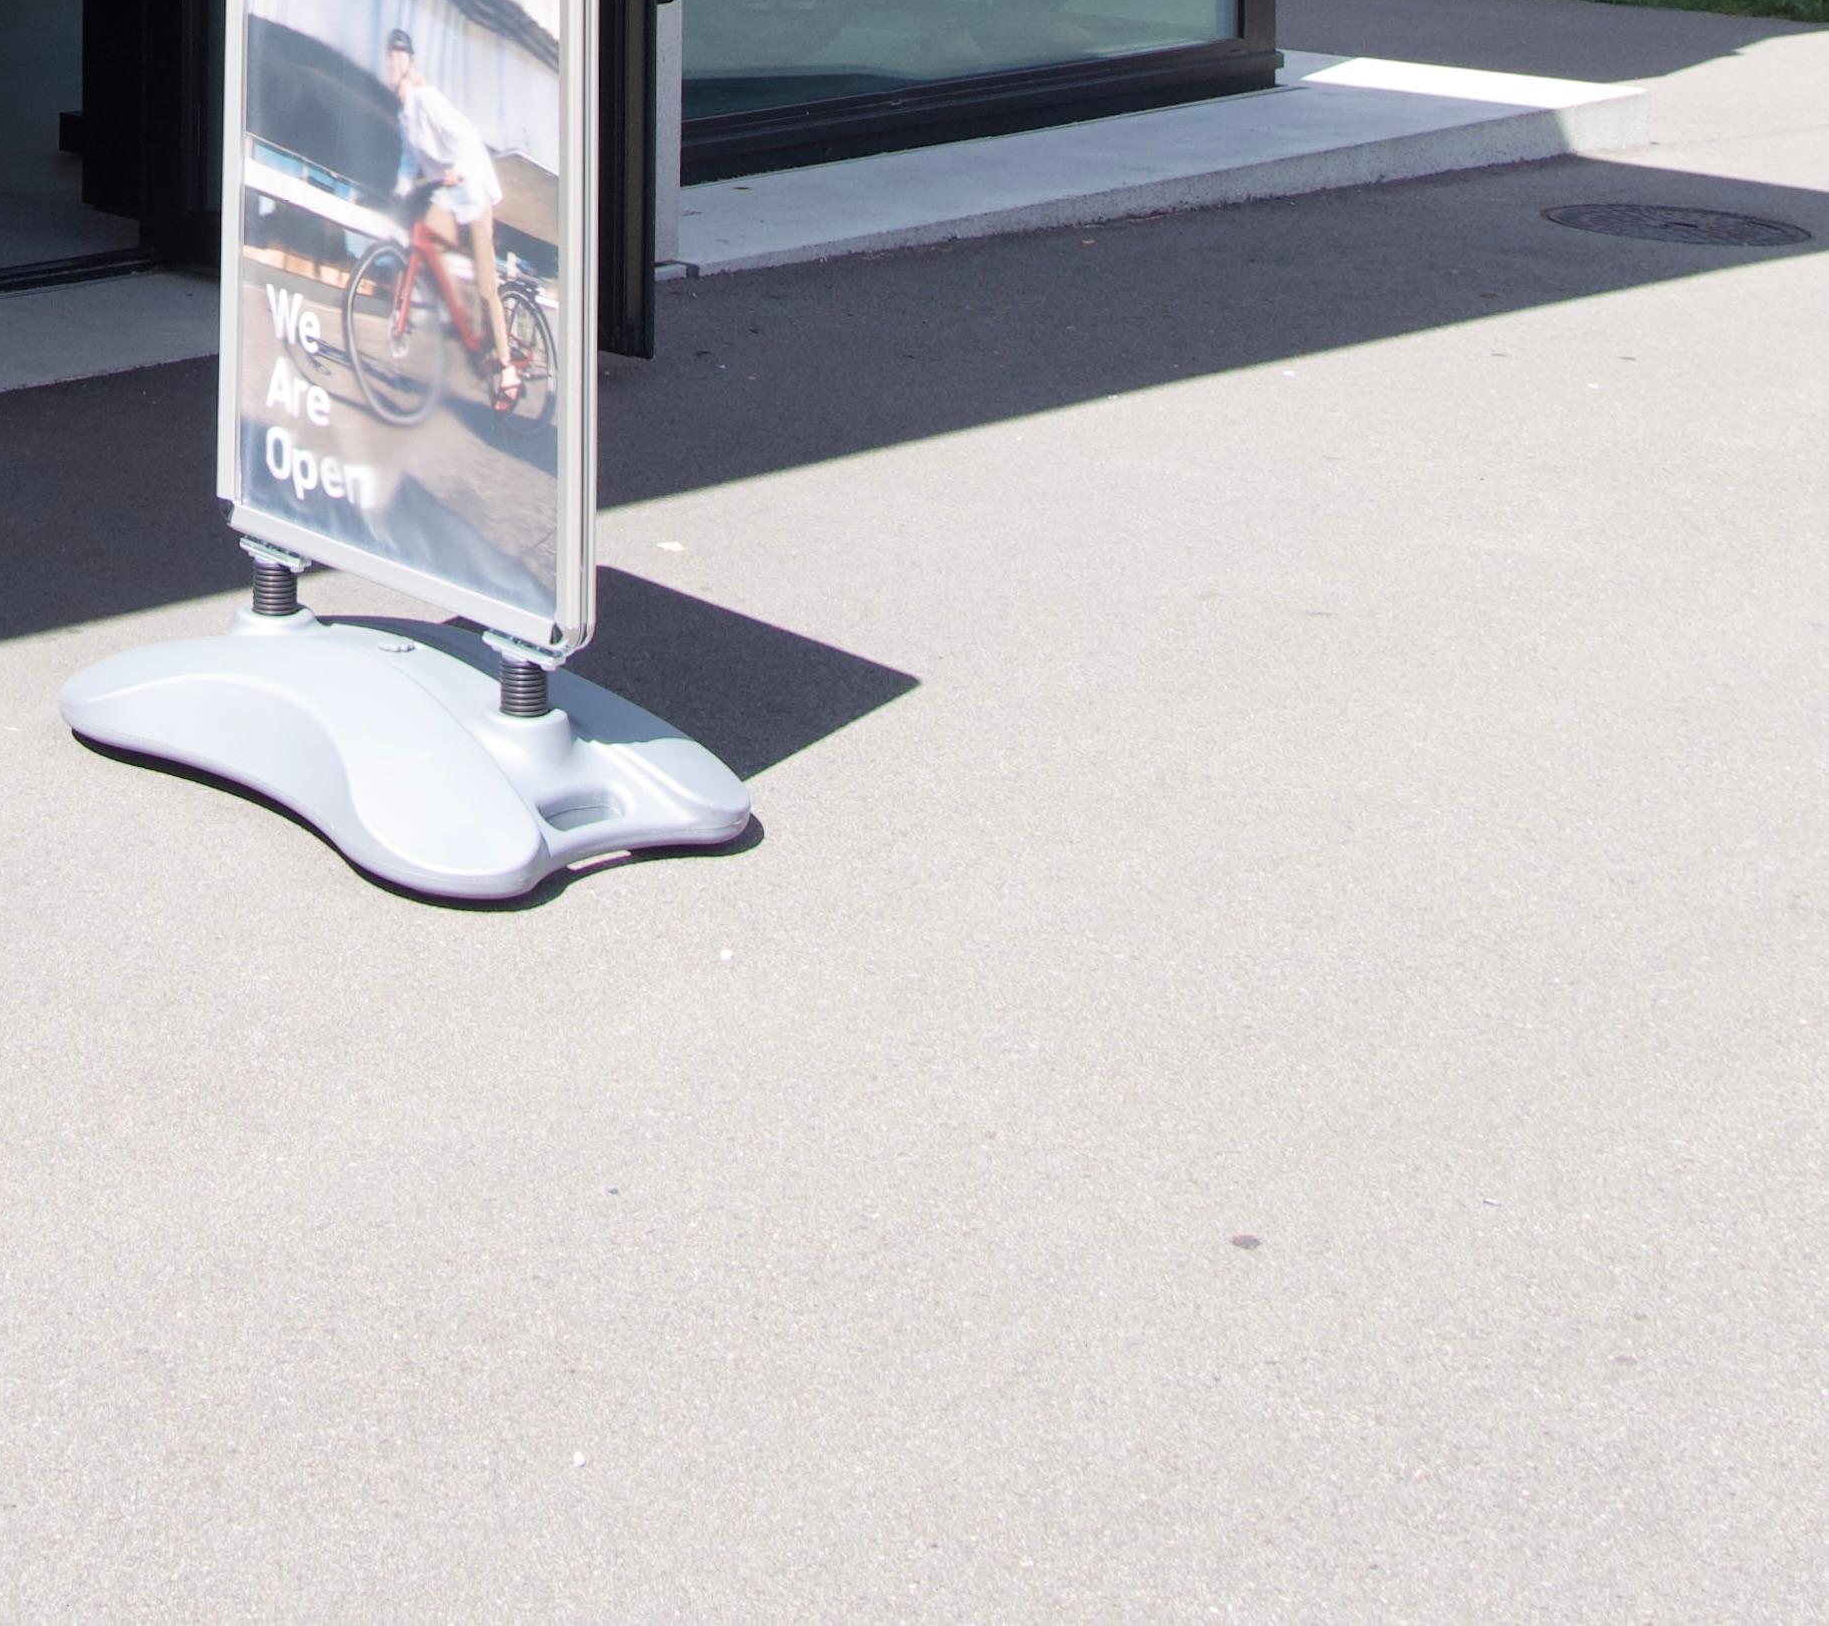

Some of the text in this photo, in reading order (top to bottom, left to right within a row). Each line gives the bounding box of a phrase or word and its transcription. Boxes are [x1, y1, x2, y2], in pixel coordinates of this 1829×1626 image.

[265, 282, 321, 354] We
[265, 357, 331, 427] Are
[265, 425, 376, 510] Open
